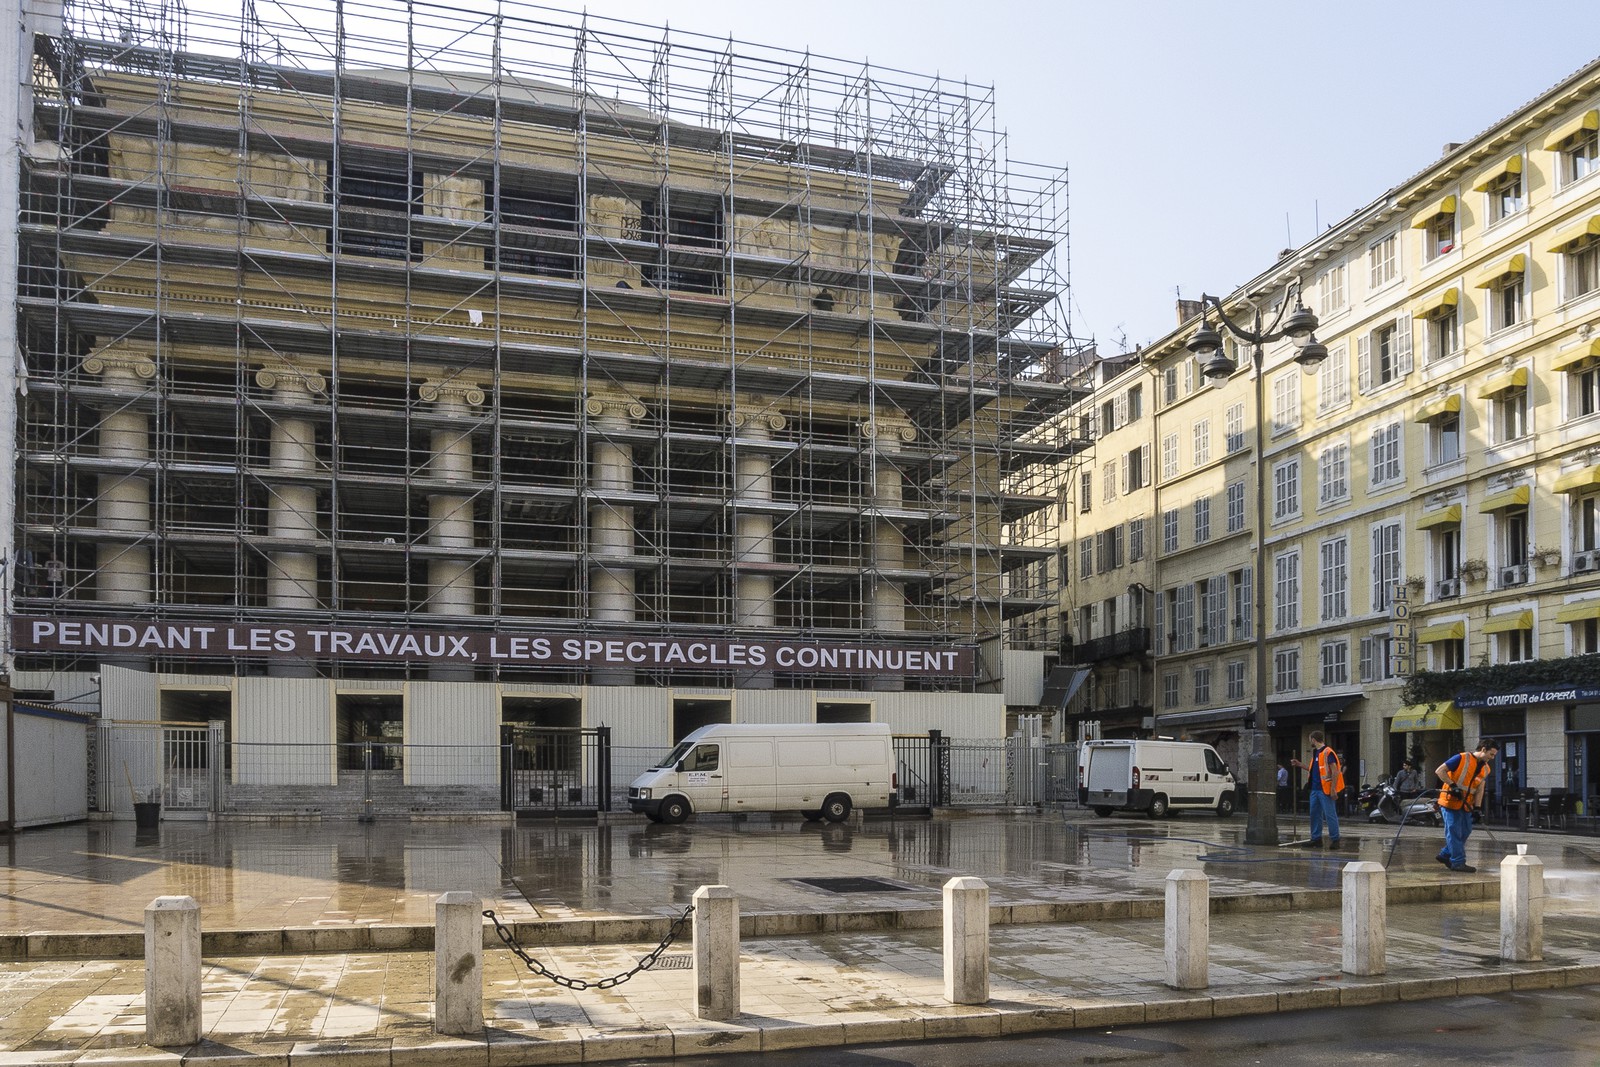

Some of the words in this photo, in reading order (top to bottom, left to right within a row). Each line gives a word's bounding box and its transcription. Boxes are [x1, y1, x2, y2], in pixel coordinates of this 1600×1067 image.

[32, 621, 215, 649] PENDANT
[228, 628, 296, 651] LES
[307, 630, 478, 661] TRAVAUX,
[490, 637, 551, 659] LES
[562, 638, 766, 666] SPECTACLES
[776, 646, 959, 671] CONTINUENT
[1396, 587, 1407, 673] HOTEL
[1486, 693, 1528, 706] COMPTOIR
[1528, 694, 1539, 703] de
